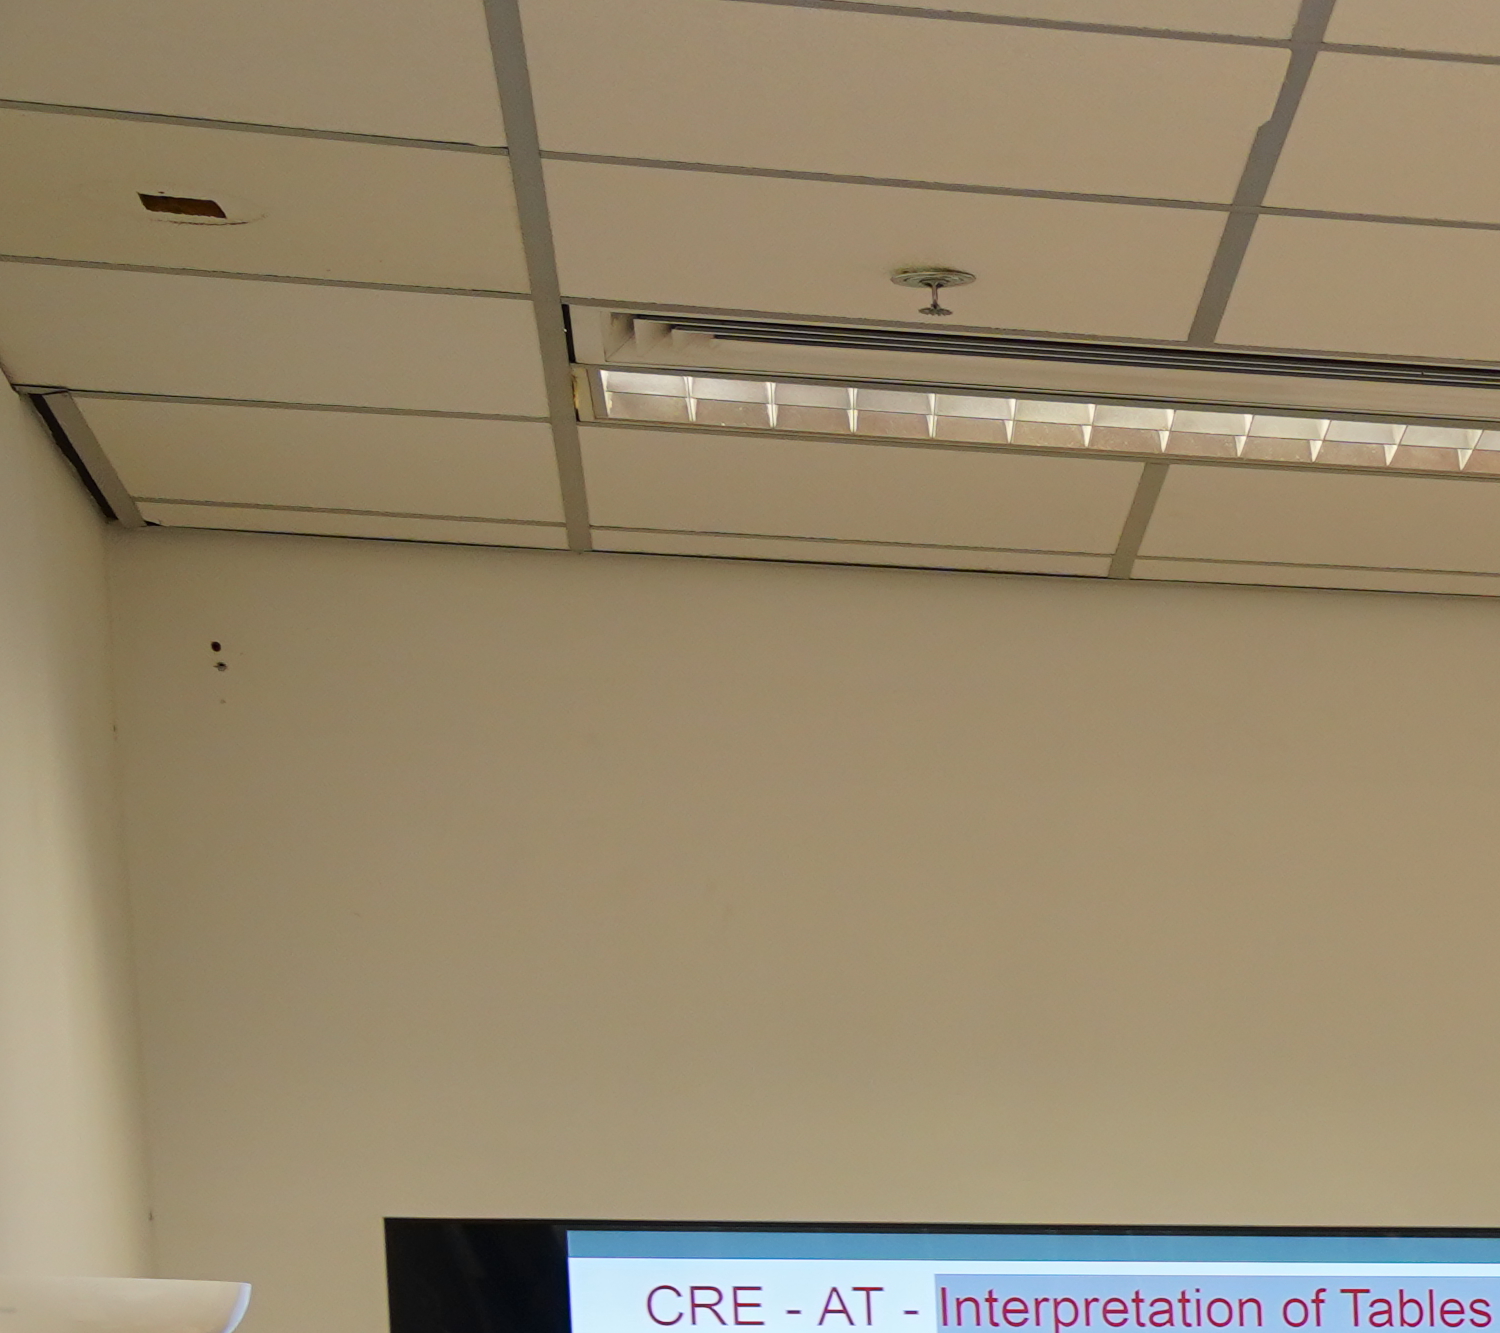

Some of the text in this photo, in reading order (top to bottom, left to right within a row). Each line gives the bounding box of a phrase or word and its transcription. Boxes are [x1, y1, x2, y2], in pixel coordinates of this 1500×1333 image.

[646, 1284, 765, 1326] CRE
[818, 1287, 884, 1326] AT
[1282, 1288, 1327, 1328] of
[1340, 1288, 1492, 1328] Tables
